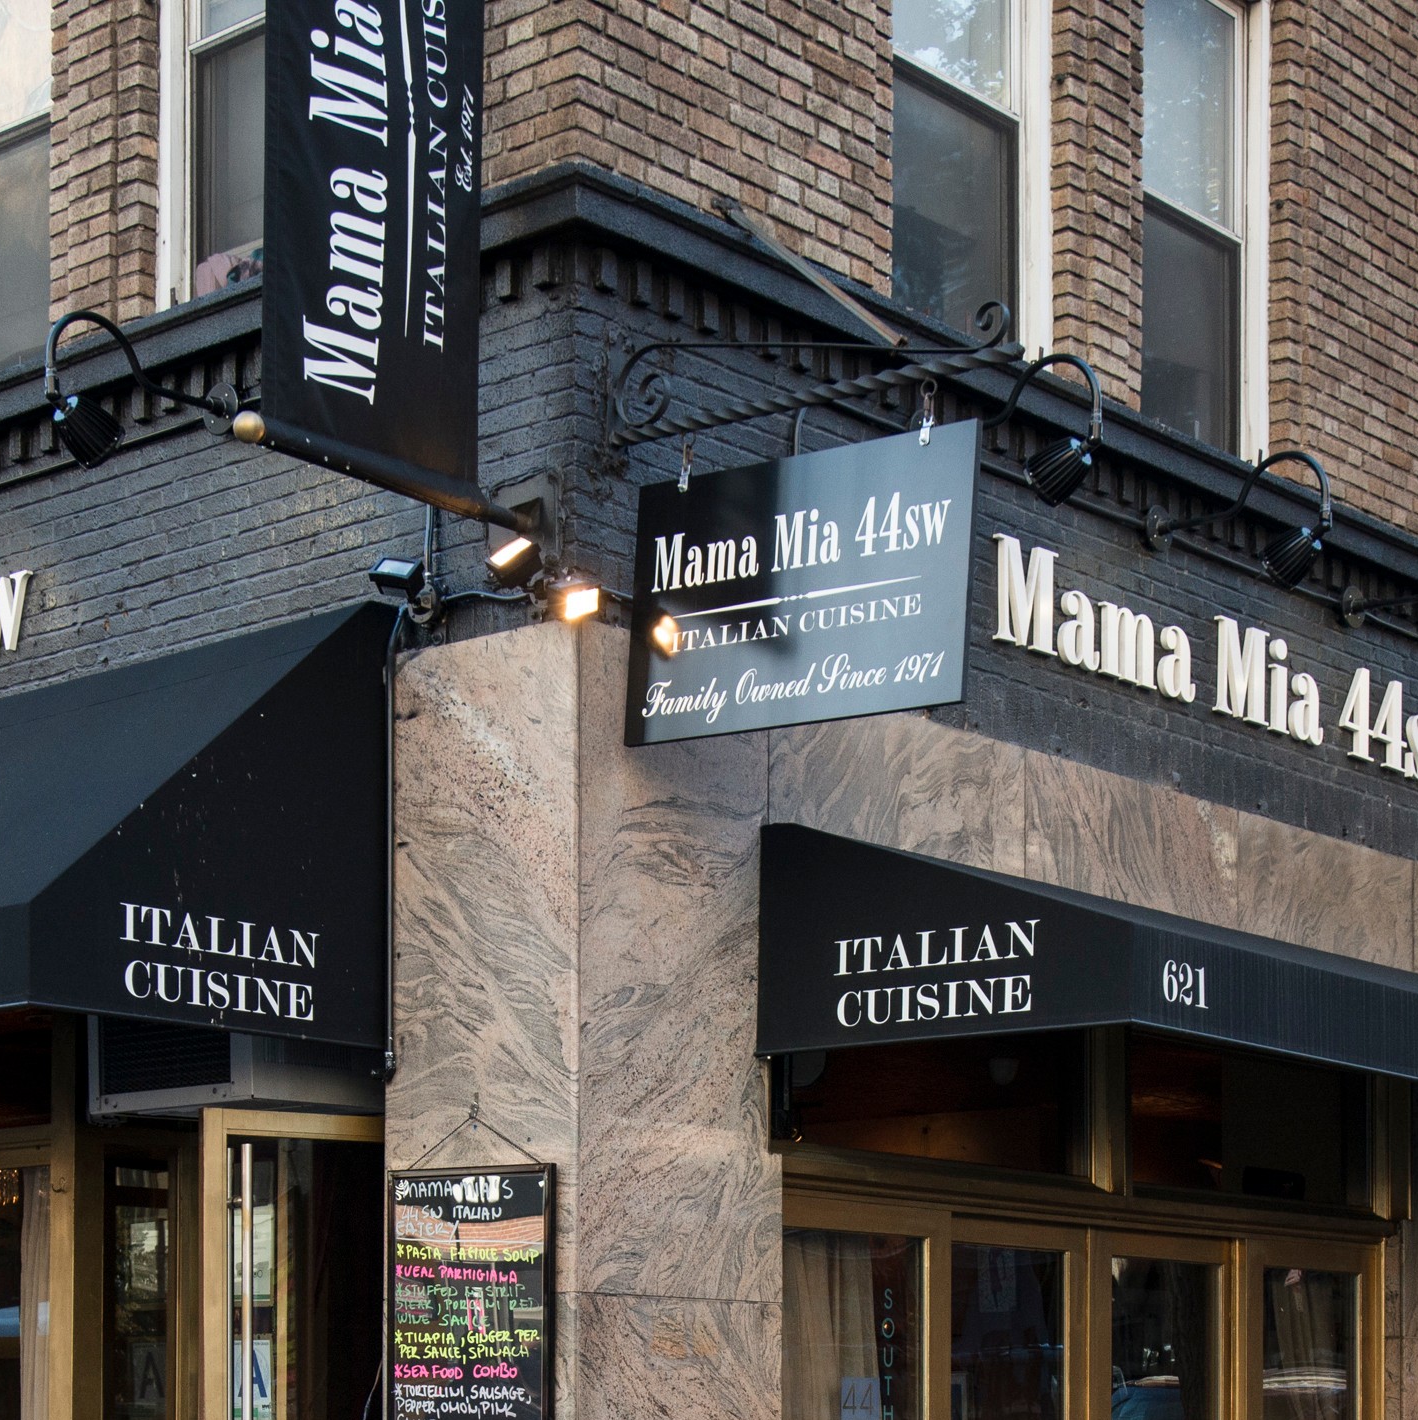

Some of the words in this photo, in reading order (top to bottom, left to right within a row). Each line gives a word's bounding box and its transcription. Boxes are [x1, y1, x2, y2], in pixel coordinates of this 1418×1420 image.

[309, 0, 388, 147] Mia
[461, 84, 474, 143] 1971
[423, 117, 449, 353] ITALIAN
[303, 167, 388, 406] Mama
[651, 533, 759, 593] Mama
[771, 508, 841, 573] Mia
[669, 615, 791, 654] ITALIAN
[799, 592, 922, 633] CUISINE
[992, 532, 1196, 704] Mama
[1211, 614, 1324, 747] Mia
[641, 679, 727, 724] Family
[735, 663, 816, 706] Owned
[817, 653, 887, 694] Since
[894, 650, 945, 684] 1971
[119, 901, 321, 969] ITALIAN
[833, 919, 1041, 977] ITALIAN
[124, 959, 315, 1022] CUISINE
[836, 974, 1032, 1028] CUISINE
[1162, 958, 1210, 1010] 621
[396, 1220, 460, 1243] EATERY
[452, 1205, 502, 1221] ITALIAN
[504, 1248, 540, 1264] SOUP
[485, 1284, 526, 1298] STRIP
[399, 1345, 421, 1359] PER
[468, 1345, 529, 1360] SPINACH
[473, 1362, 517, 1379] COMBO
[842, 1382, 875, 1416] 44
